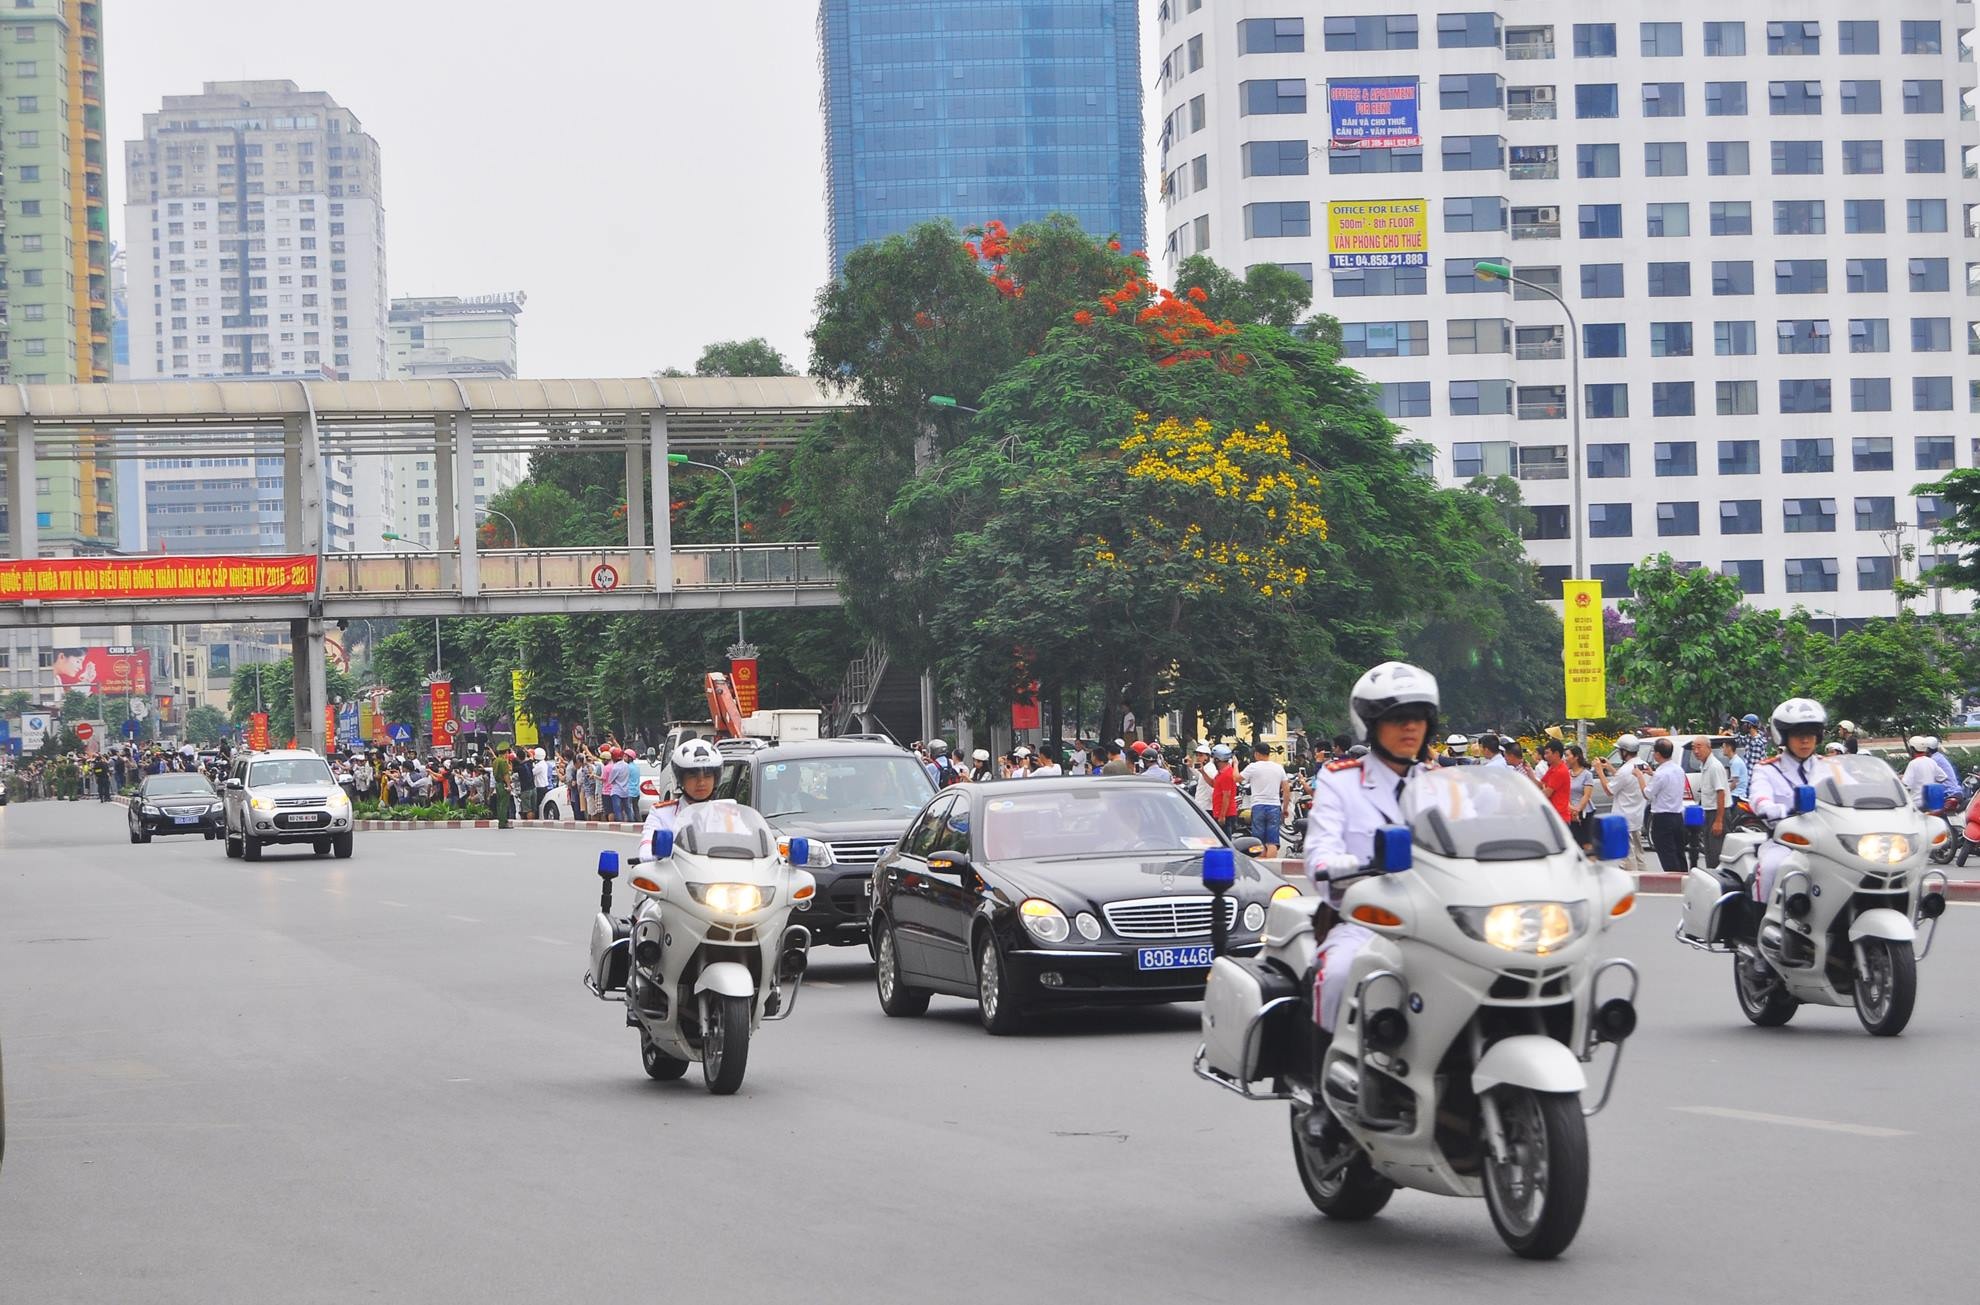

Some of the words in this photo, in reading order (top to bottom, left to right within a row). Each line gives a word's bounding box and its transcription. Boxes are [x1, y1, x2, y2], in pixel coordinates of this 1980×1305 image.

[1356, 102, 1370, 115] FOR
[1371, 102, 1391, 114] RENT
[1333, 206, 1364, 214] OFFICE
[1369, 206, 1387, 214] FOR
[1390, 205, 1420, 213] LEASE
[1374, 218, 1386, 229] 8th
[1389, 217, 1414, 228] FLOOR
[1383, 234, 1399, 248] CHO
[1334, 255, 1353, 267] TEL:
[1355, 254, 1423, 266] 04.858.21.888
[59, 570, 72, 590] XIV
[73, 565, 84, 590] VÀ
[155, 564, 177, 589] NHÂN
[178, 564, 194, 588] DÂN
[195, 564, 211, 588] CÁC
[212, 561, 228, 587] CẤP
[255, 563, 265, 587] KỲ
[267, 566, 285, 586] 2016
[292, 565, 308, 585] 2021
